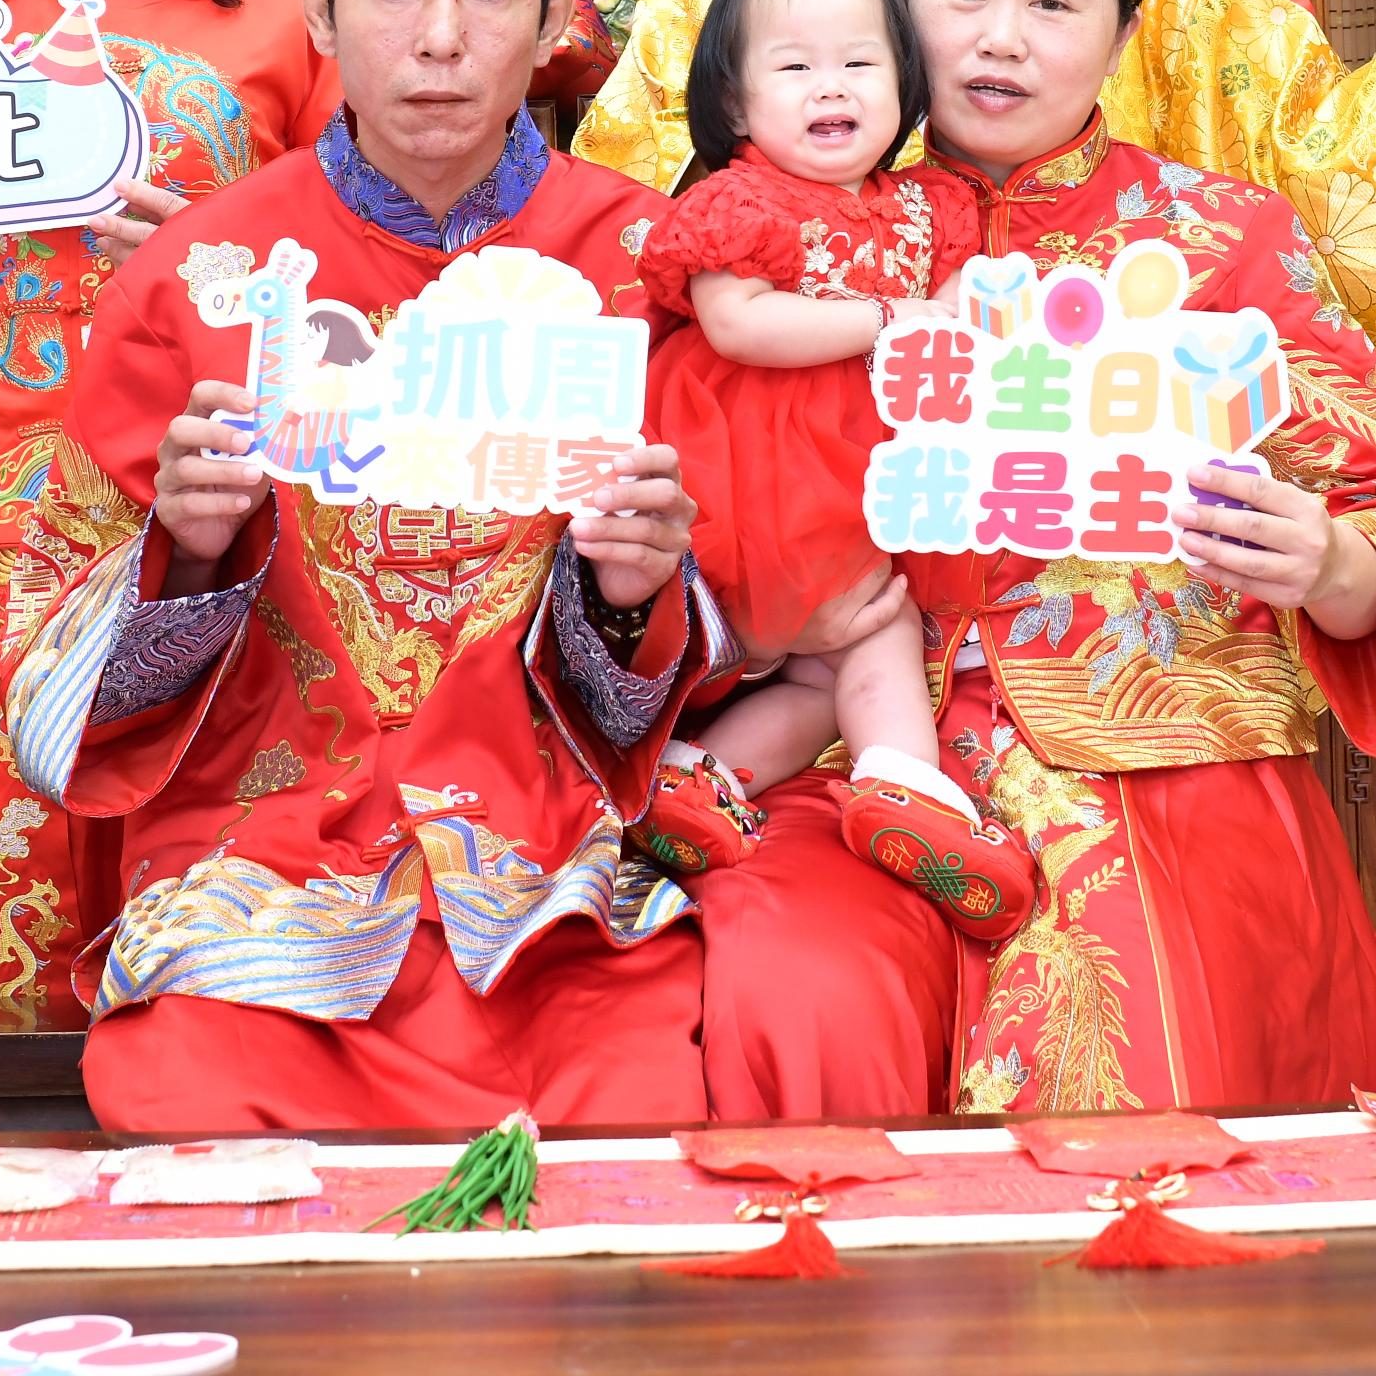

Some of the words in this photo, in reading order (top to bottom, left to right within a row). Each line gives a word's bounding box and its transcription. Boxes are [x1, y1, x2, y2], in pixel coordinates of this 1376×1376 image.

[392, 310, 639, 427] 抓周
[882, 328, 1160, 438] 我生日
